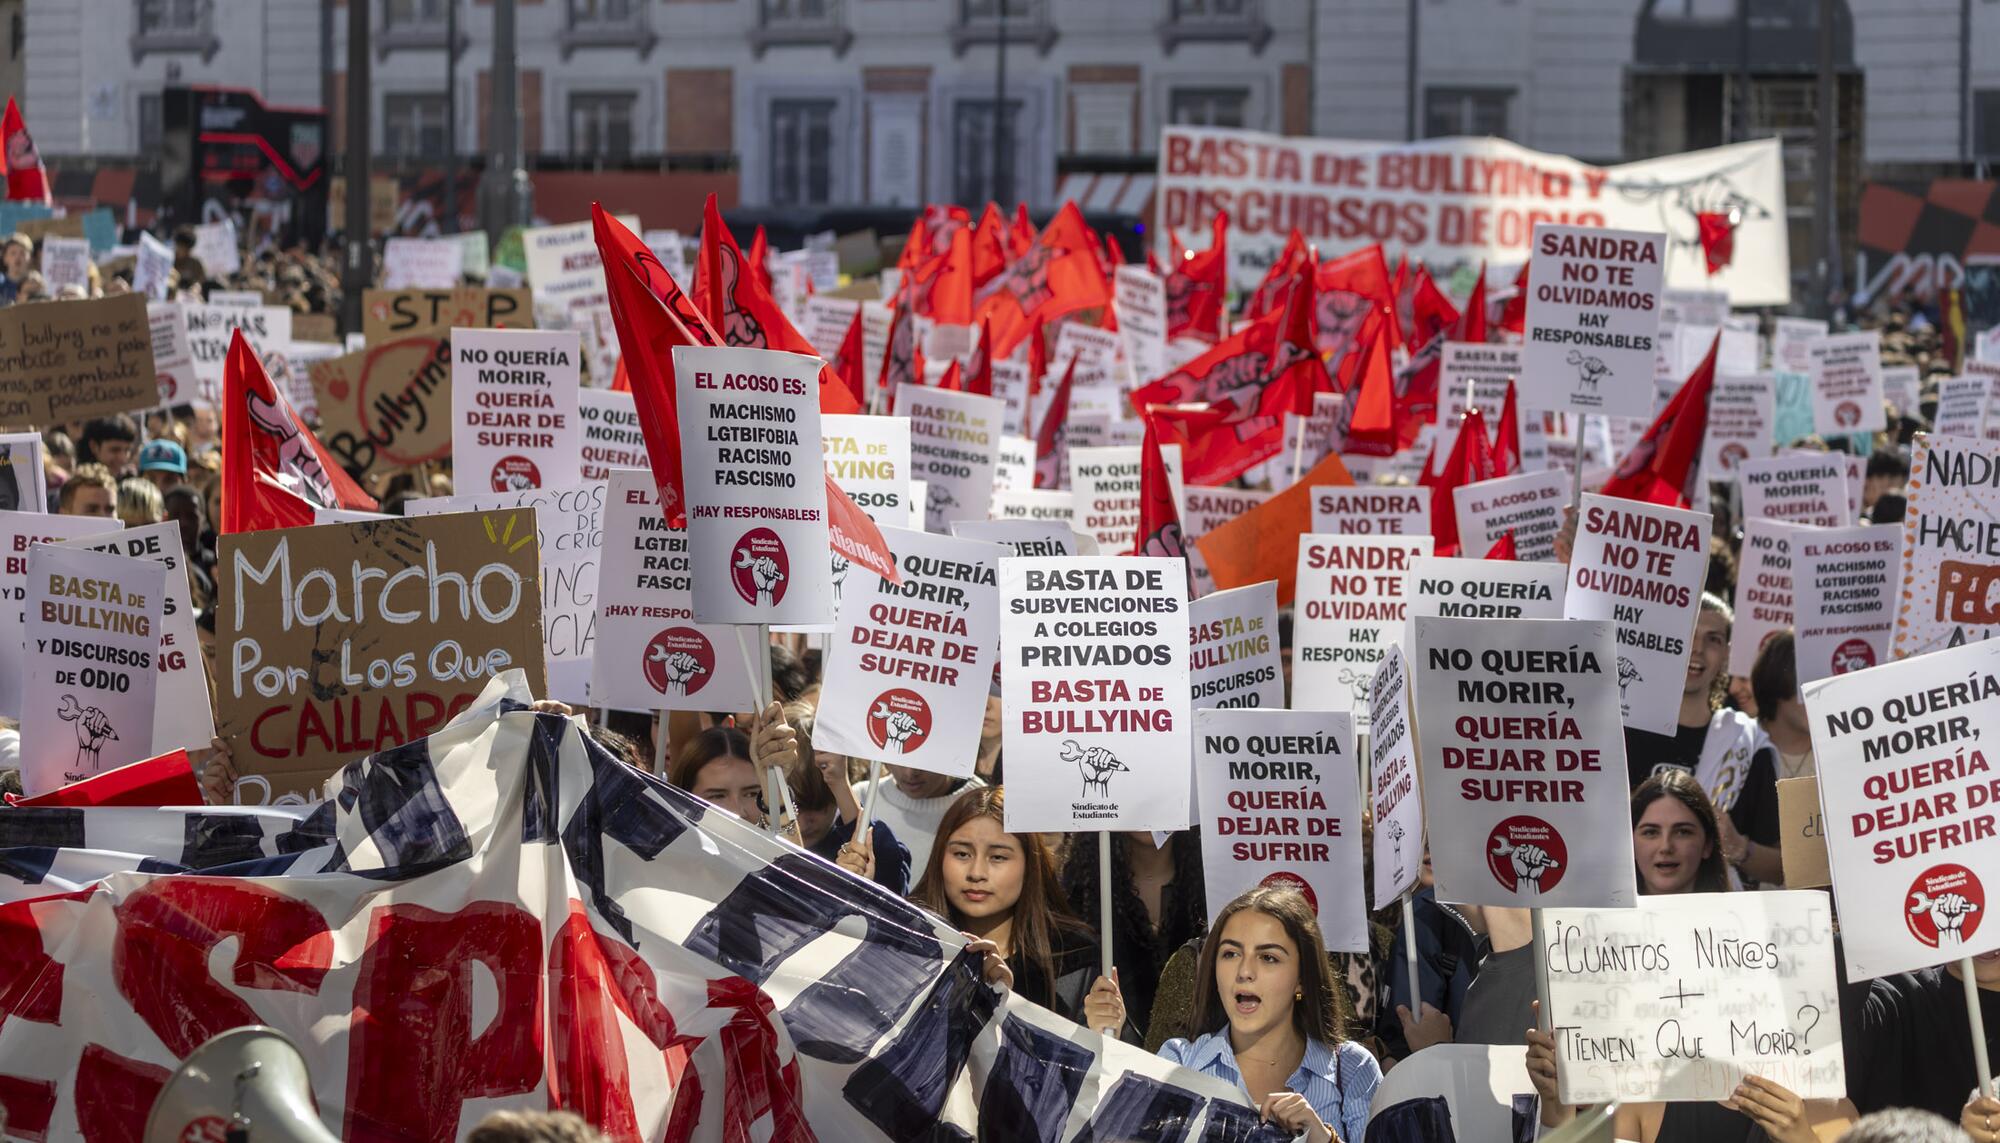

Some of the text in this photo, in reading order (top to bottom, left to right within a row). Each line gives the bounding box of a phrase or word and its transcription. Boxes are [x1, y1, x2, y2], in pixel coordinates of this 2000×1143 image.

[1166, 135, 1608, 198] BASTA DE BULLYING Y
[1164, 186, 1490, 247] DISCURSOS DE
[1541, 233, 1657, 264] SANDRA
[1562, 263, 1634, 286] NO TE
[1538, 285, 1654, 311] OLVIDAMOS
[389, 293, 518, 330] STP
[1578, 313, 1609, 328] HAY
[1532, 328, 1652, 350] RESPONSABLES
[461, 347, 570, 367] NO QUERÍA
[478, 370, 552, 388] MORIR,
[695, 373, 807, 396] EL ACOSO ES:
[475, 389, 555, 409] QUERÍA
[467, 411, 566, 428] DEJAR DE
[579, 405, 599, 421] NO
[710, 403, 796, 423] MACHISMO
[912, 403, 967, 423] BASTA
[477, 431, 554, 448] SUFRIR
[707, 426, 799, 446] LGTBIFOBIA
[582, 446, 651, 469] QUERÍA
[718, 448, 792, 466] RACISMO
[866, 443, 888, 455] DE
[911, 442, 989, 465] DISCURSOS
[715, 470, 796, 489] FASCISMO
[928, 460, 971, 479] ODIO
[1078, 465, 1102, 477] NO
[1748, 464, 1838, 485] NO QUERÍA
[626, 490, 650, 504] EL
[1471, 487, 1560, 513] EL ACOSO ES:
[1764, 483, 1825, 499] MORIR,
[692, 506, 820, 522] ¡HAY RESPONSABLES!
[1004, 505, 1027, 517] NO
[1319, 495, 1421, 514] SANDRA
[1763, 499, 1828, 517] QUERÍA
[1340, 518, 1403, 534] NO TE
[1485, 506, 1556, 529] MACHISMO
[1586, 507, 1700, 552] SANDRA
[128, 536, 161, 557] DE
[1010, 537, 1066, 556] UERÍA
[1751, 535, 1773, 550] NO
[1805, 540, 1894, 556] EL ACOSO ES:
[904, 555, 997, 586] QUERÍA
[1602, 542, 1675, 577] NO TE
[1816, 560, 1886, 574] MACHISMO
[49, 574, 146, 609] BASTA DE
[234, 536, 521, 631] Marcho
[1026, 570, 1163, 591] BASTA DE
[1330, 576, 1402, 596] NO TE
[1419, 579, 1552, 601] NO QUERÍA
[1576, 567, 1690, 608] OLVIDAMOS
[1815, 574, 1886, 588] LGTBIFOBIA
[878, 576, 970, 611] MORIR,
[1823, 588, 1880, 601] RACISMO
[605, 605, 638, 618] ¡HAY
[1010, 598, 1178, 614] SUBVENCIONES
[1614, 604, 1643, 624] HAY
[1821, 602, 1882, 615] FASCISMO
[41, 601, 150, 637] BULLYING
[869, 604, 968, 637] QUERÍA
[1034, 621, 1157, 637] A COLEGIOS
[1190, 616, 1264, 645] BASTA DE
[1349, 629, 1379, 643] HAY
[37, 639, 47, 654] Y
[51, 638, 150, 669] DISCURSOS
[851, 626, 978, 664] DEJAR DE
[1021, 645, 1172, 667] PRIVADOS
[233, 637, 512, 698] Por Los Que
[859, 654, 959, 686] SUFRIR
[1429, 645, 1601, 675] NO QUERÍA
[55, 667, 130, 694] DE ODIO
[1031, 680, 1164, 703] BASTA DE
[1191, 666, 1275, 699] DISCURSOS
[1458, 680, 1574, 709] MORIR,
[1826, 671, 2000, 738] NO QUERÍA
[251, 692, 476, 758] CALLAR
[1022, 710, 1173, 734] BULLYING
[1455, 711, 1582, 741] QUERÍA
[1205, 732, 1341, 757] NO QUERÍA
[1375, 718, 1405, 768] PRIVADOS
[1862, 716, 1981, 763] MORIR,
[1442, 747, 1601, 772] DEJAR DE
[1229, 761, 1321, 785] MORIR,
[1378, 755, 1407, 795] BASTA DE
[1863, 747, 1990, 801] QUERÍA
[1228, 786, 1327, 810] QUERÍA
[1376, 774, 1411, 824] BULLYING
[1461, 779, 1584, 802] SUFRIR
[1071, 803, 1119, 812] Sindicato de
[1073, 811, 1119, 820] Estudiantes
[1851, 791, 1957, 838] DEJAR
[1966, 779, 2000, 809] DE
[1217, 817, 1341, 837] DEJAR DE
[1509, 825, 1538, 833] Sindicato
[1510, 832, 1550, 840] Estudiantes
[1873, 814, 1996, 865] SUFRIR
[1232, 843, 1329, 862] SUFRIR
[1925, 874, 1957, 885] Sindicato
[1927, 879, 1967, 893] Estudiantes
